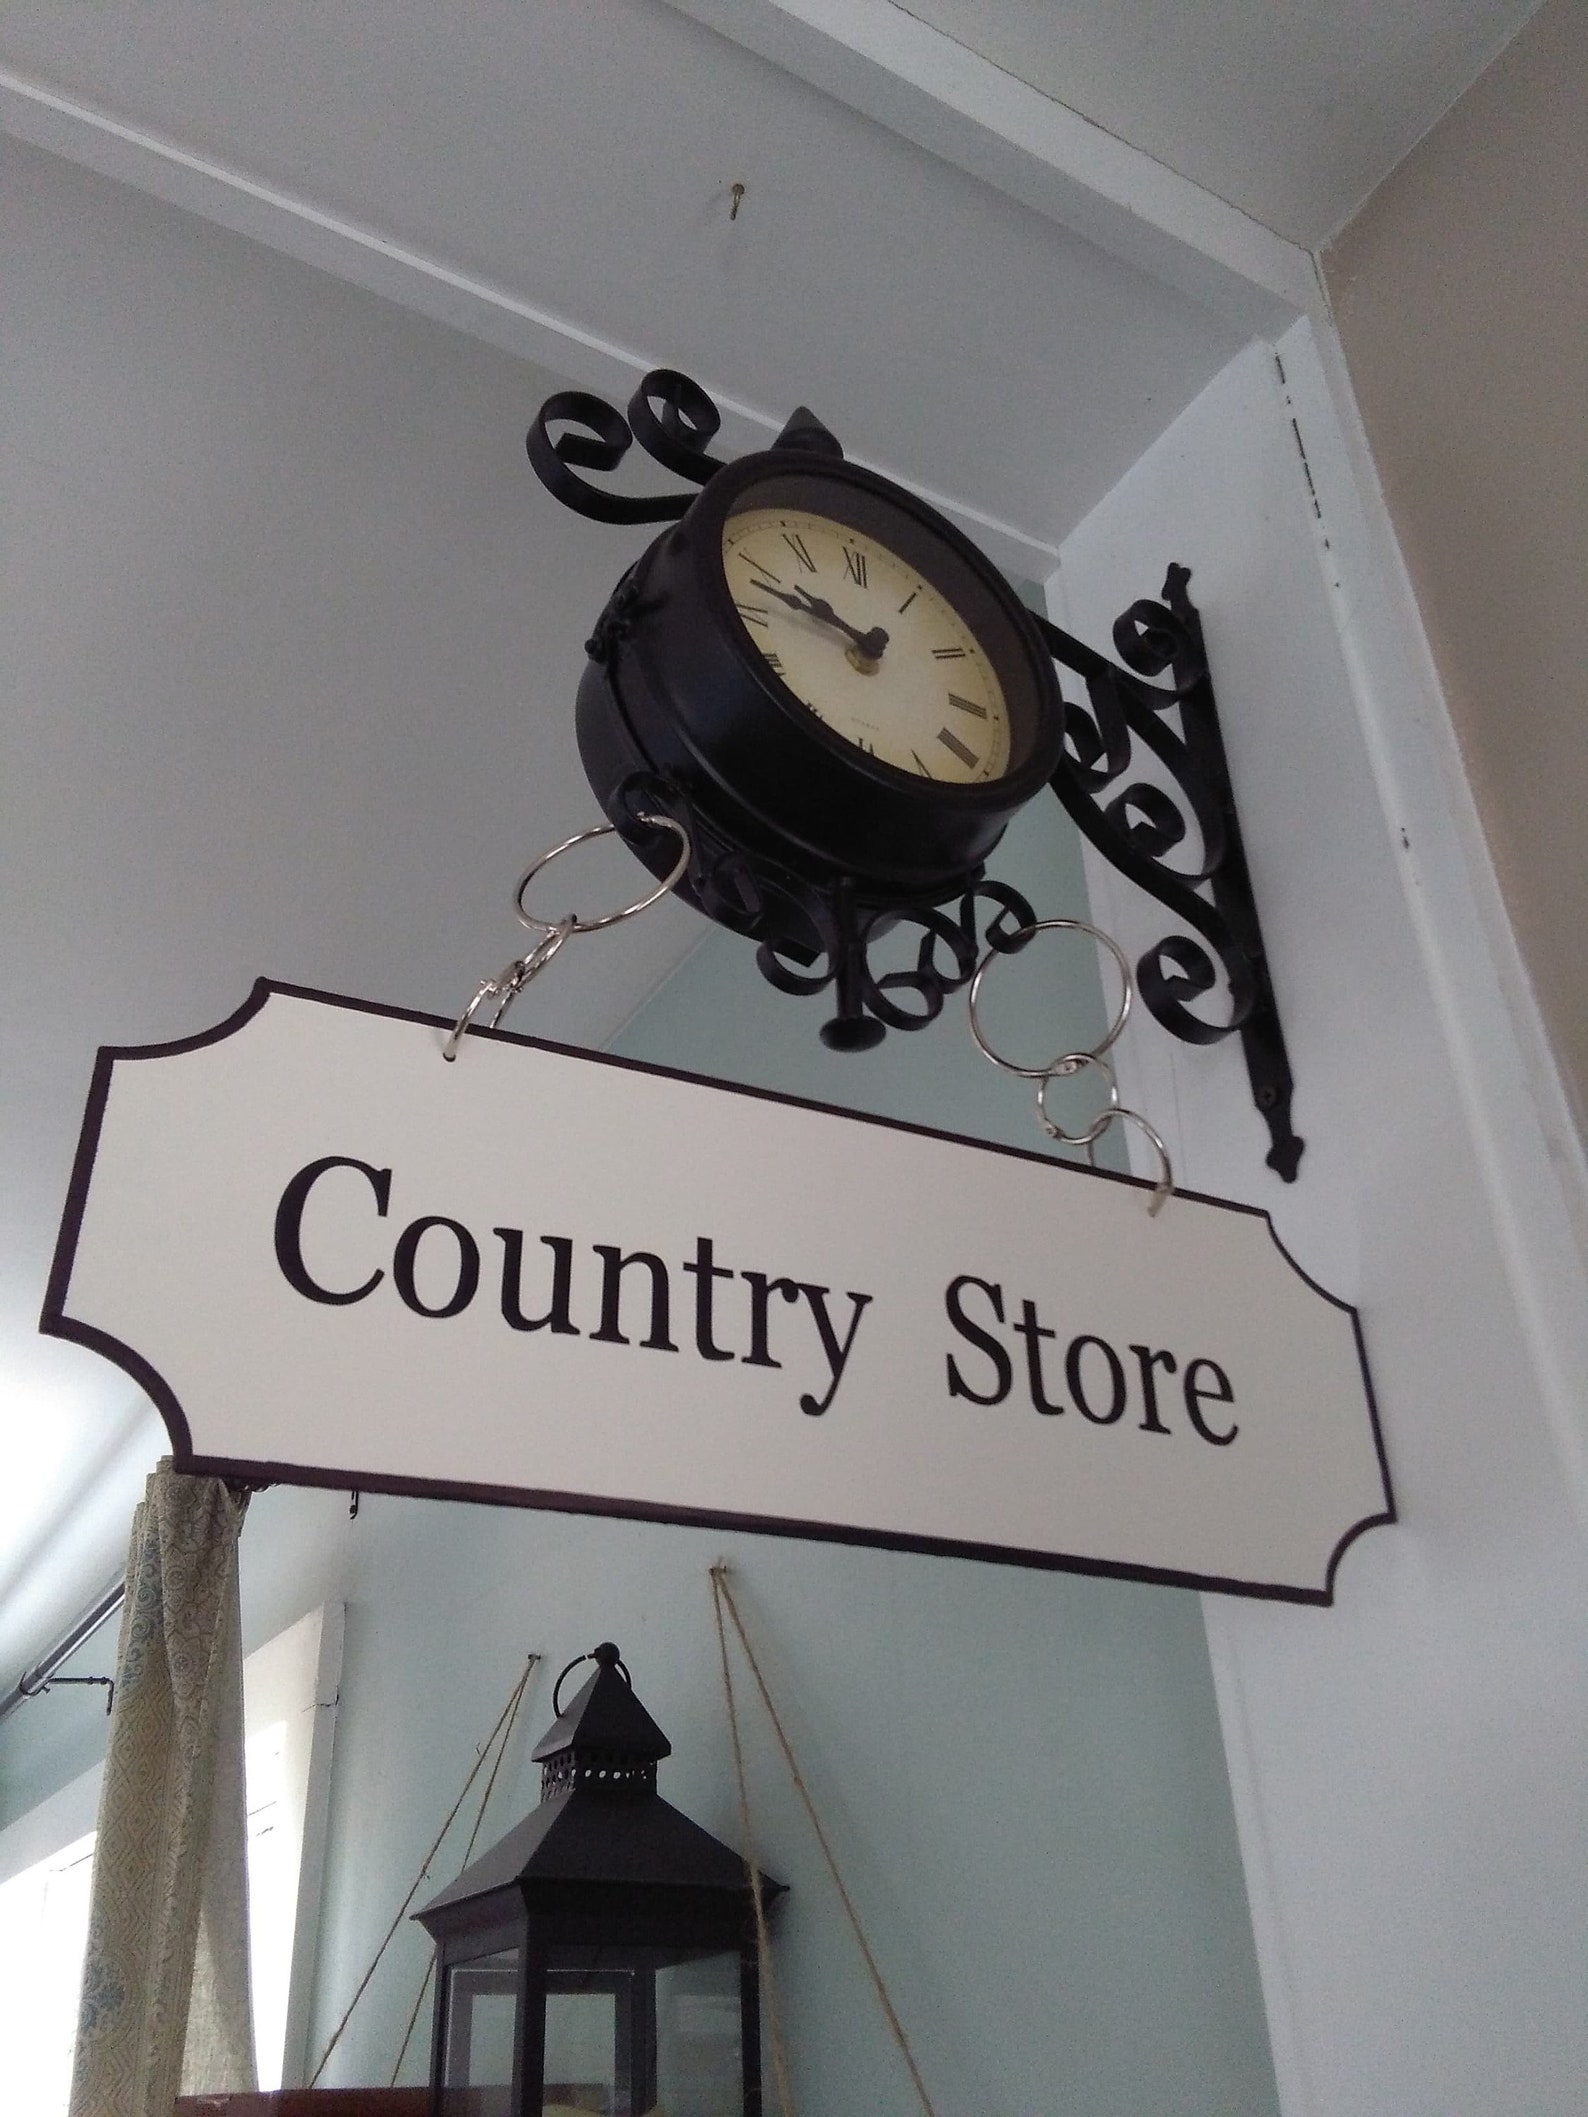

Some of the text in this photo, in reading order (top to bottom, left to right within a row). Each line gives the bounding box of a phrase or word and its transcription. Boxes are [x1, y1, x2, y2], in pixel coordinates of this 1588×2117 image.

[842, 546, 868, 589] XII
[275, 1156, 1239, 1446] Country Store
